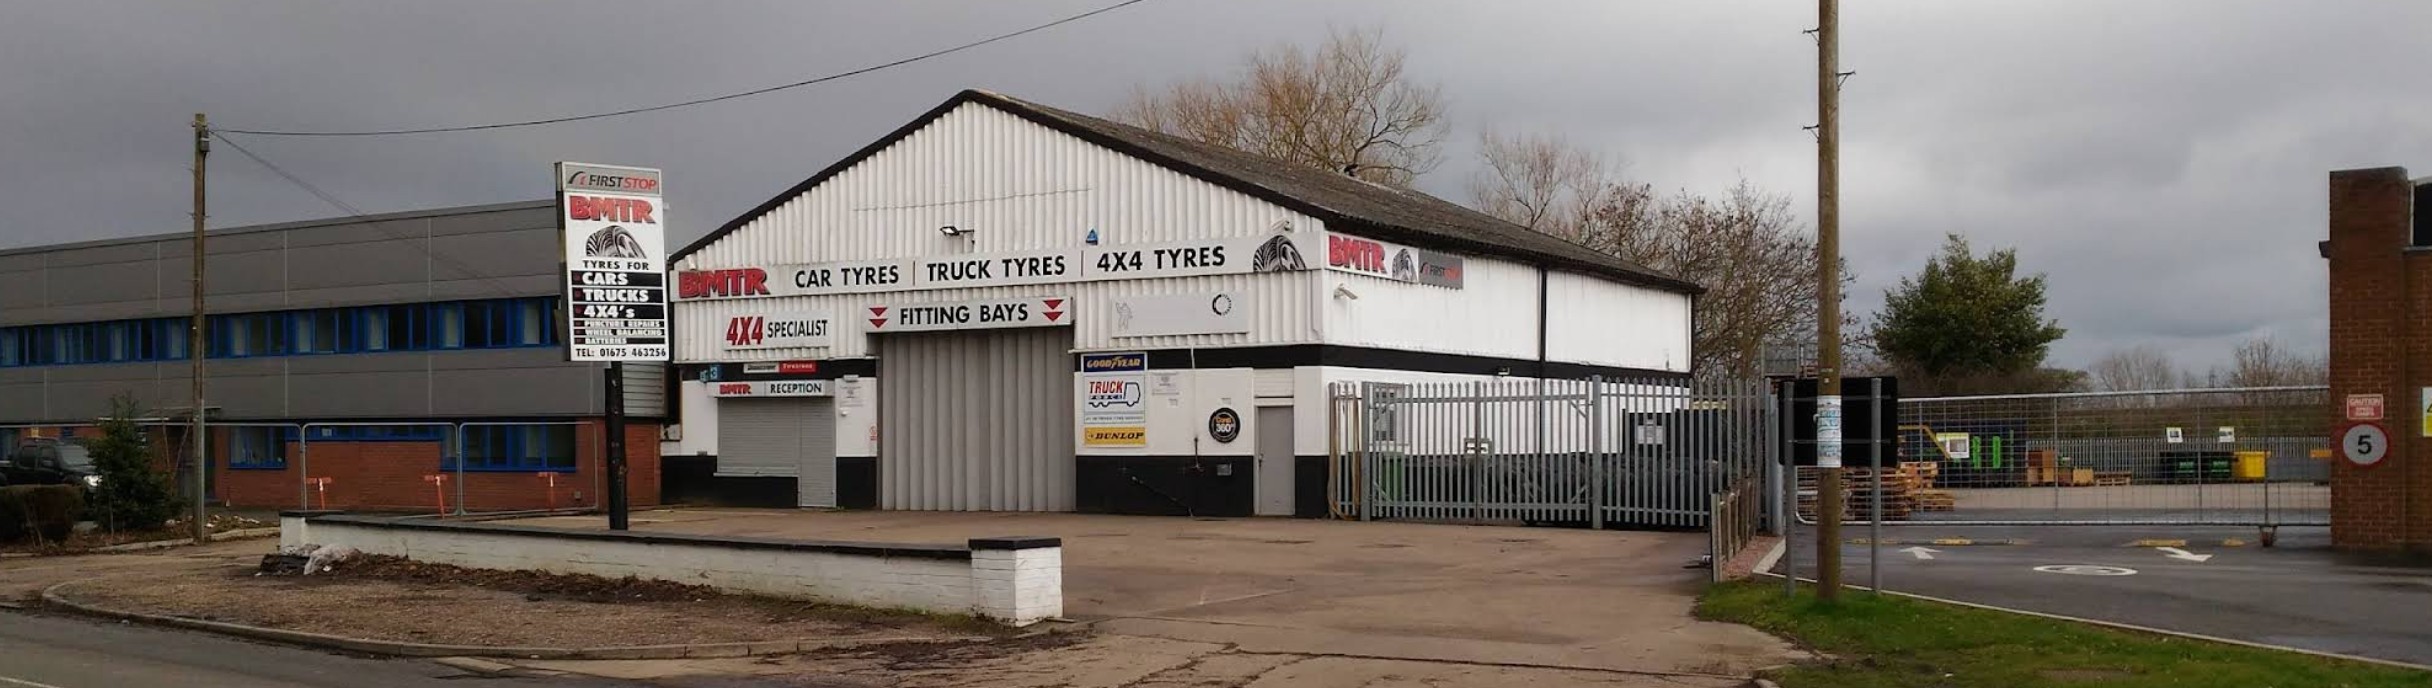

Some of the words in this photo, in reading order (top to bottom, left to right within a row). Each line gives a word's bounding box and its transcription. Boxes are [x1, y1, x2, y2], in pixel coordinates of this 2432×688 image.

[569, 195, 657, 224] BMTR
[1097, 250, 1143, 272] 4X4
[1154, 245, 1226, 270] TYRES
[1328, 234, 1388, 275] BMTR
[583, 259, 620, 269] TYRES
[627, 261, 650, 271] FOR
[927, 259, 992, 282] TRUCK
[1002, 255, 1066, 278] TYRES
[582, 271, 629, 286] CARS
[679, 267, 770, 299] BMTR
[795, 269, 832, 288] CAR
[841, 265, 899, 286] TYRES
[582, 288, 650, 303] TRUCKS
[584, 305, 636, 319] 4X4's
[900, 304, 970, 326] FITTING
[980, 303, 1029, 323] BAYS
[726, 316, 764, 346] 4X4
[767, 319, 828, 339] SPECIALIST
[576, 348, 595, 357] TEL:
[600, 348, 627, 357] 01675
[632, 348, 667, 357] 463256
[770, 383, 822, 394] RECEPTION
[1089, 380, 1124, 394] TRUCK
[1095, 431, 1145, 440] DUNLOP
[2357, 434, 2373, 455] 5
